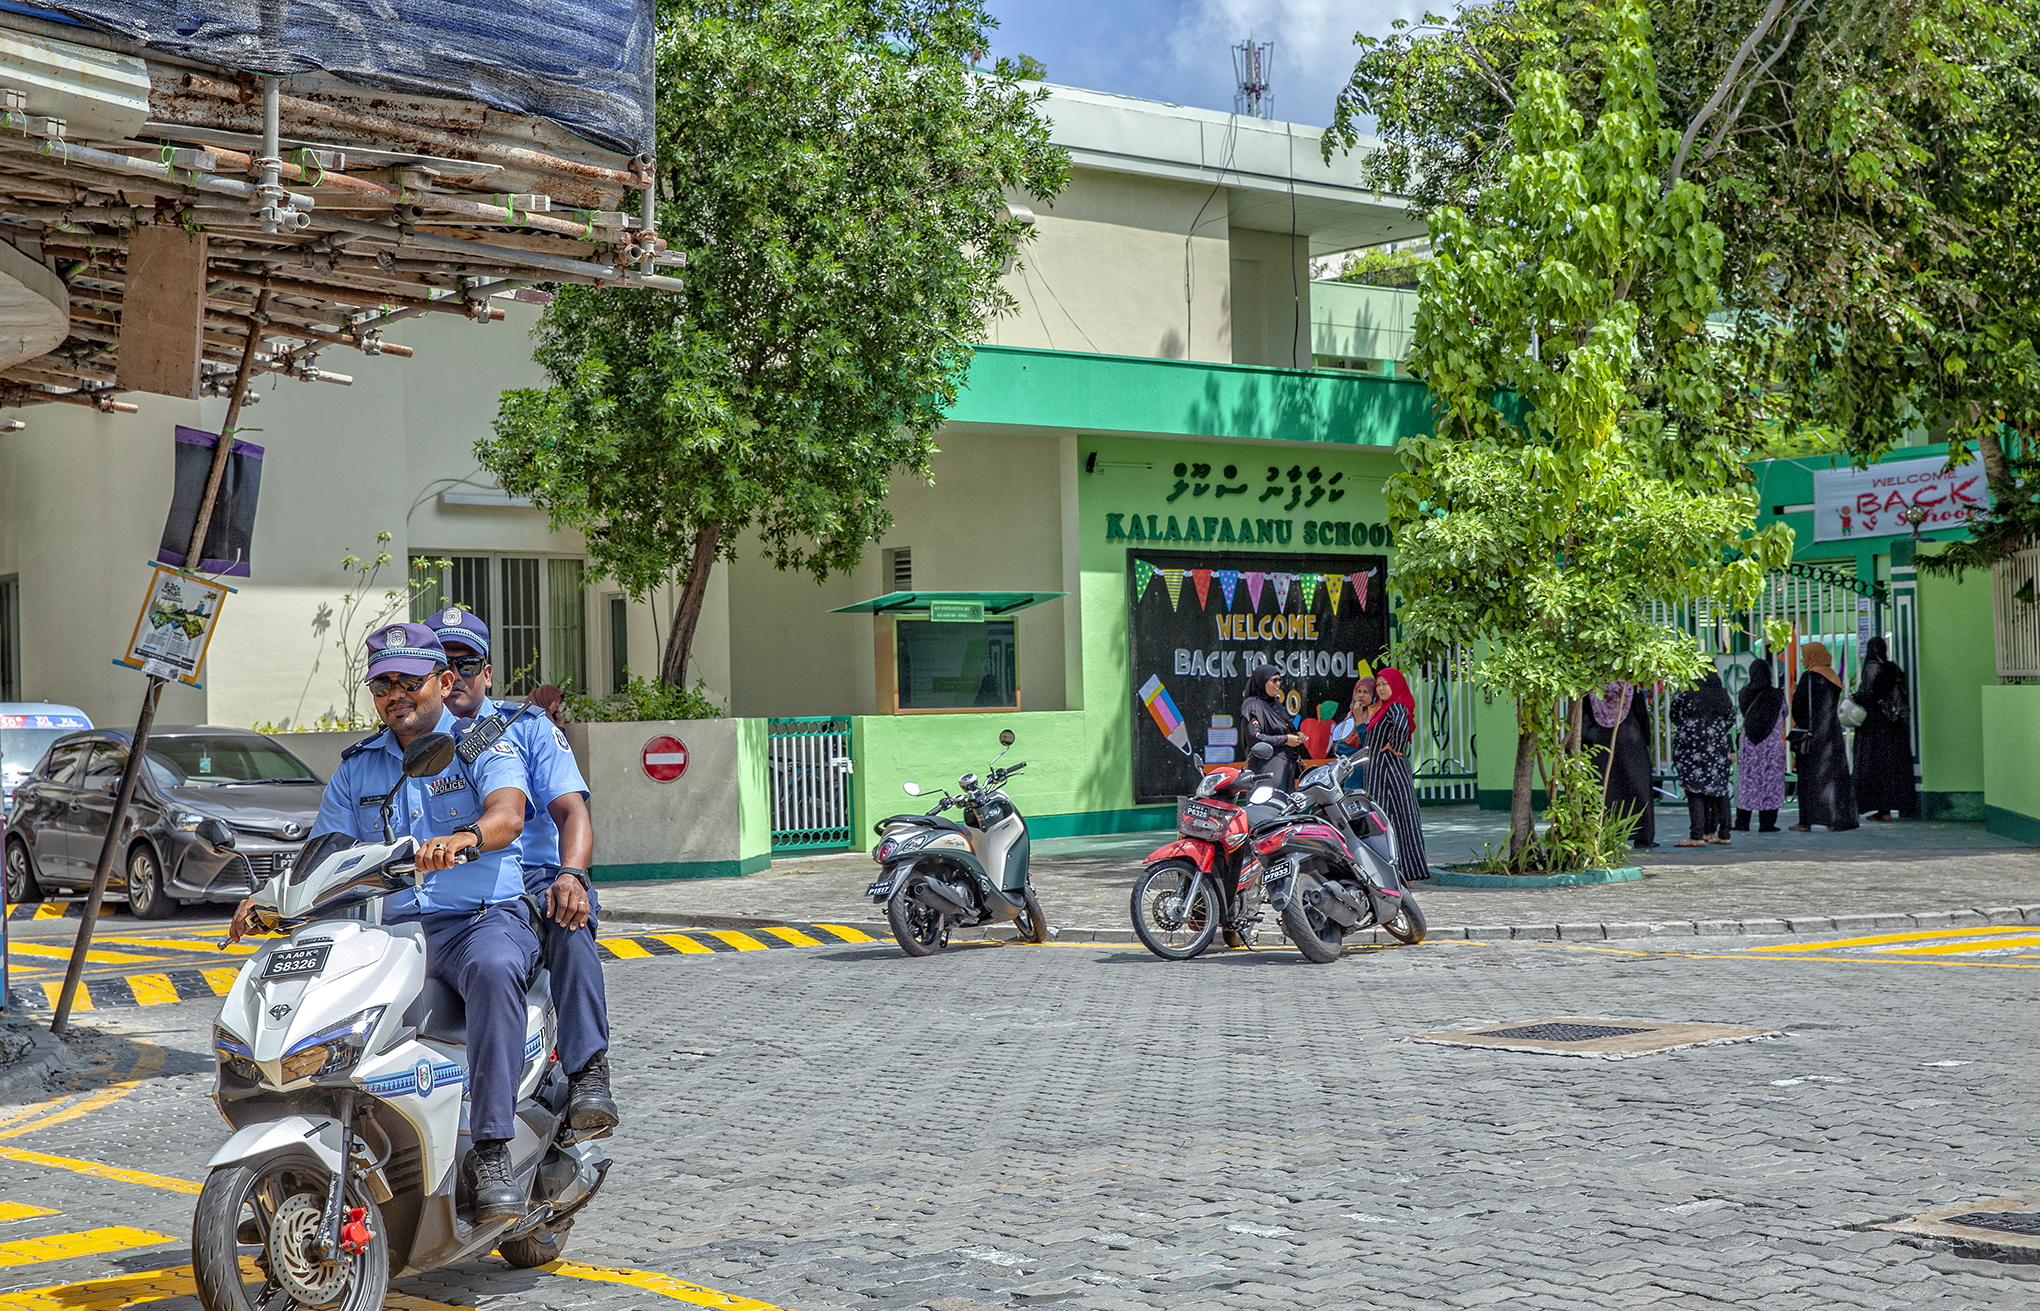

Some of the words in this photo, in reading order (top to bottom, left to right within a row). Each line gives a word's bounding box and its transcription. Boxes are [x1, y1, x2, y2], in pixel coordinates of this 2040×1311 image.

[1872, 470, 1957, 488] WELCOME
[1856, 475, 1979, 515] BACK
[1106, 512, 1293, 544] KALAAFAANU
[1216, 613, 1320, 642] WELCOME
[1174, 648, 1238, 678] BACK
[1274, 650, 1360, 678] SCHOOL
[434, 779, 465, 794] POLICE
[1264, 867, 1288, 882] P7033
[867, 886, 890, 895] P1517
[272, 958, 317, 973] S8326
